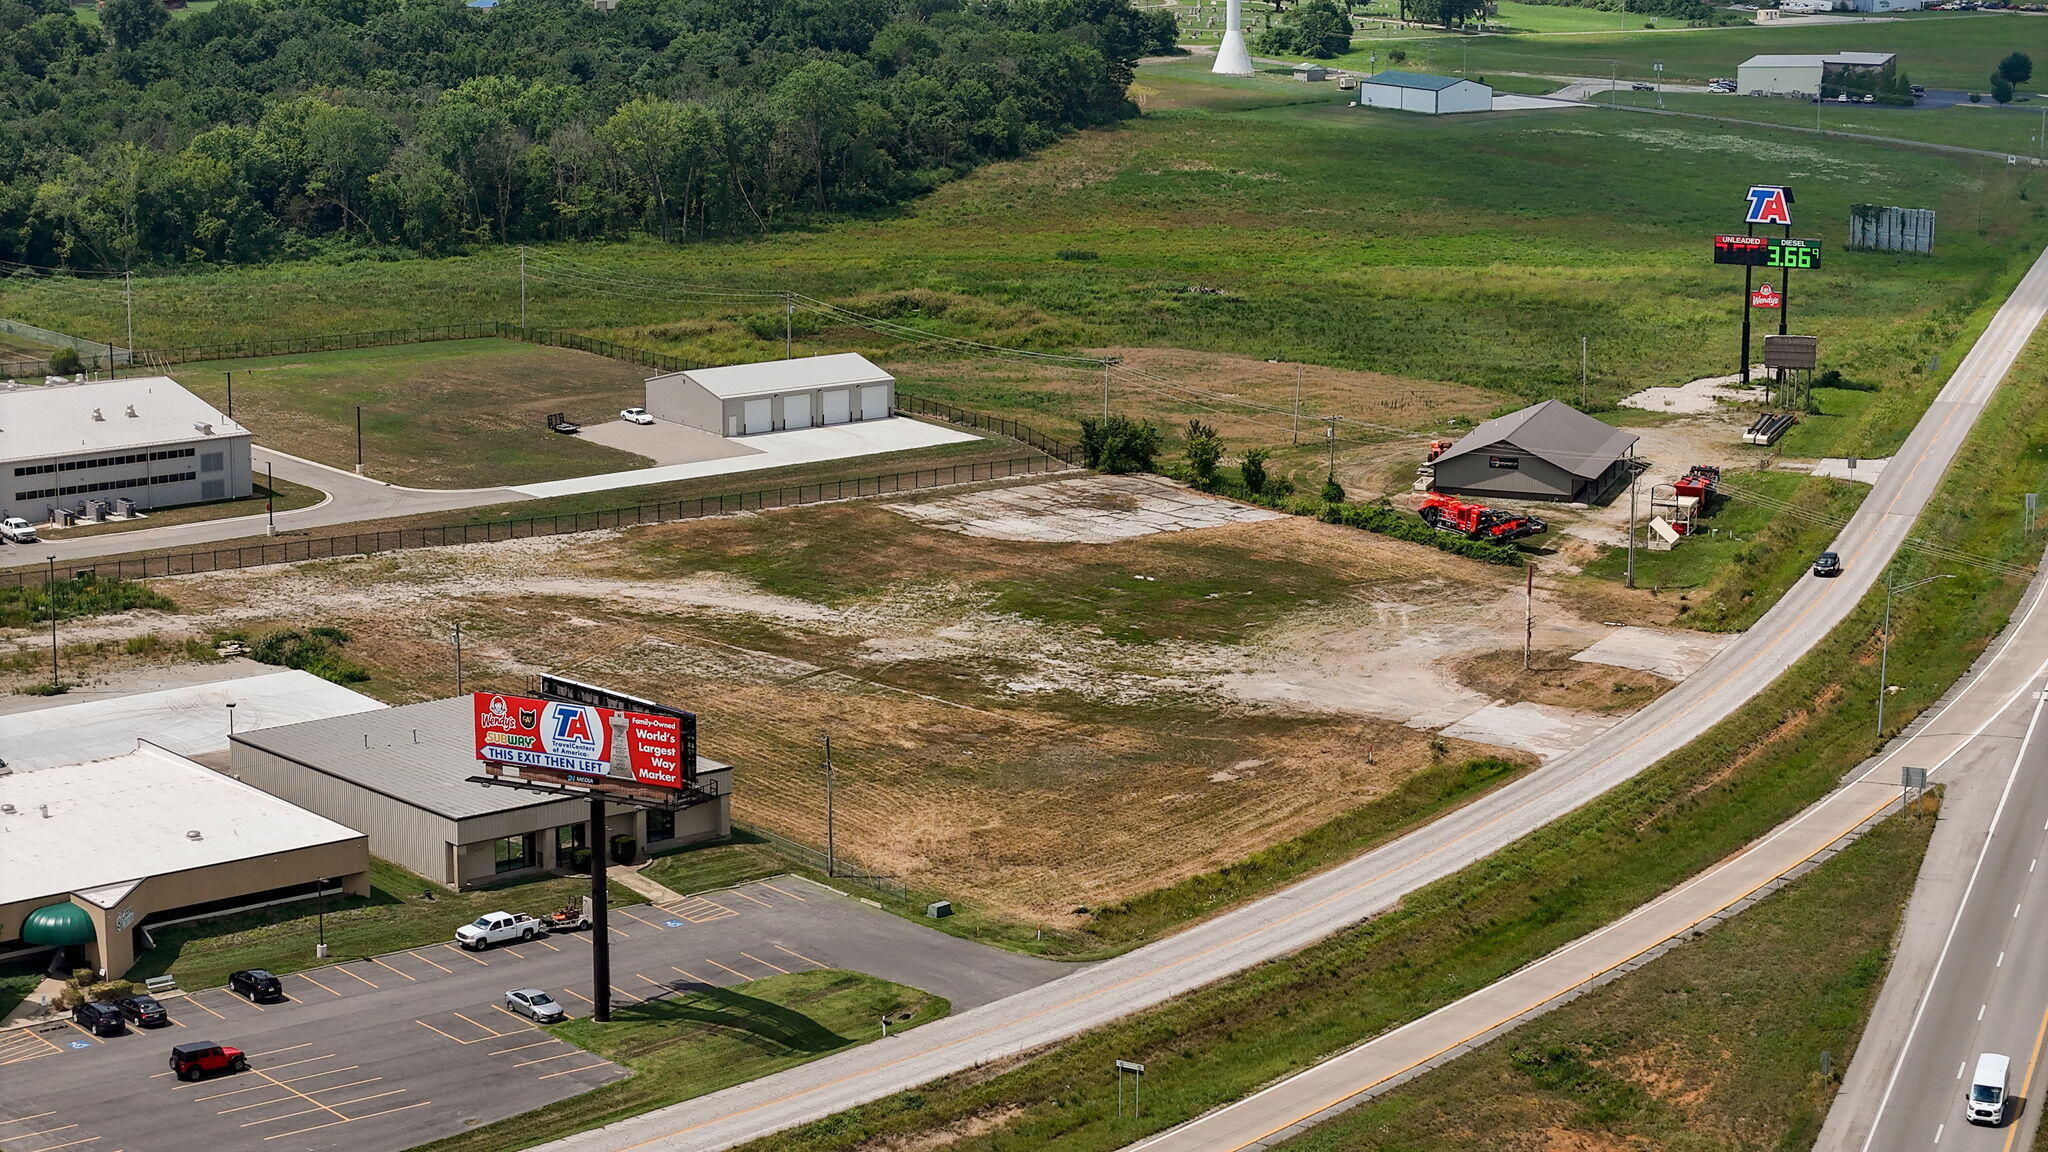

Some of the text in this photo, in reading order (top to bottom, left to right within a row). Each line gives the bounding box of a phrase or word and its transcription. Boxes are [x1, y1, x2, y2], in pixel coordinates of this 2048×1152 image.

[1746, 187, 1791, 224] TA
[1722, 236, 1761, 245] UNLEADED
[1781, 239, 1806, 247] DIESEL
[1752, 295, 1779, 307] Wendy's
[482, 713, 516, 731] Wendy's
[554, 705, 593, 744] TA
[632, 717, 676, 730] Family-Owned
[486, 731, 536, 748] SUBWAY
[636, 728, 676, 743] World's
[552, 740, 595, 752] TravelCenters
[561, 748, 587, 757] America
[638, 742, 676, 757] Largest
[489, 748, 603, 773] THIS EXIT THEN LEFT
[651, 757, 676, 772] Way
[639, 768, 676, 783] Marker
